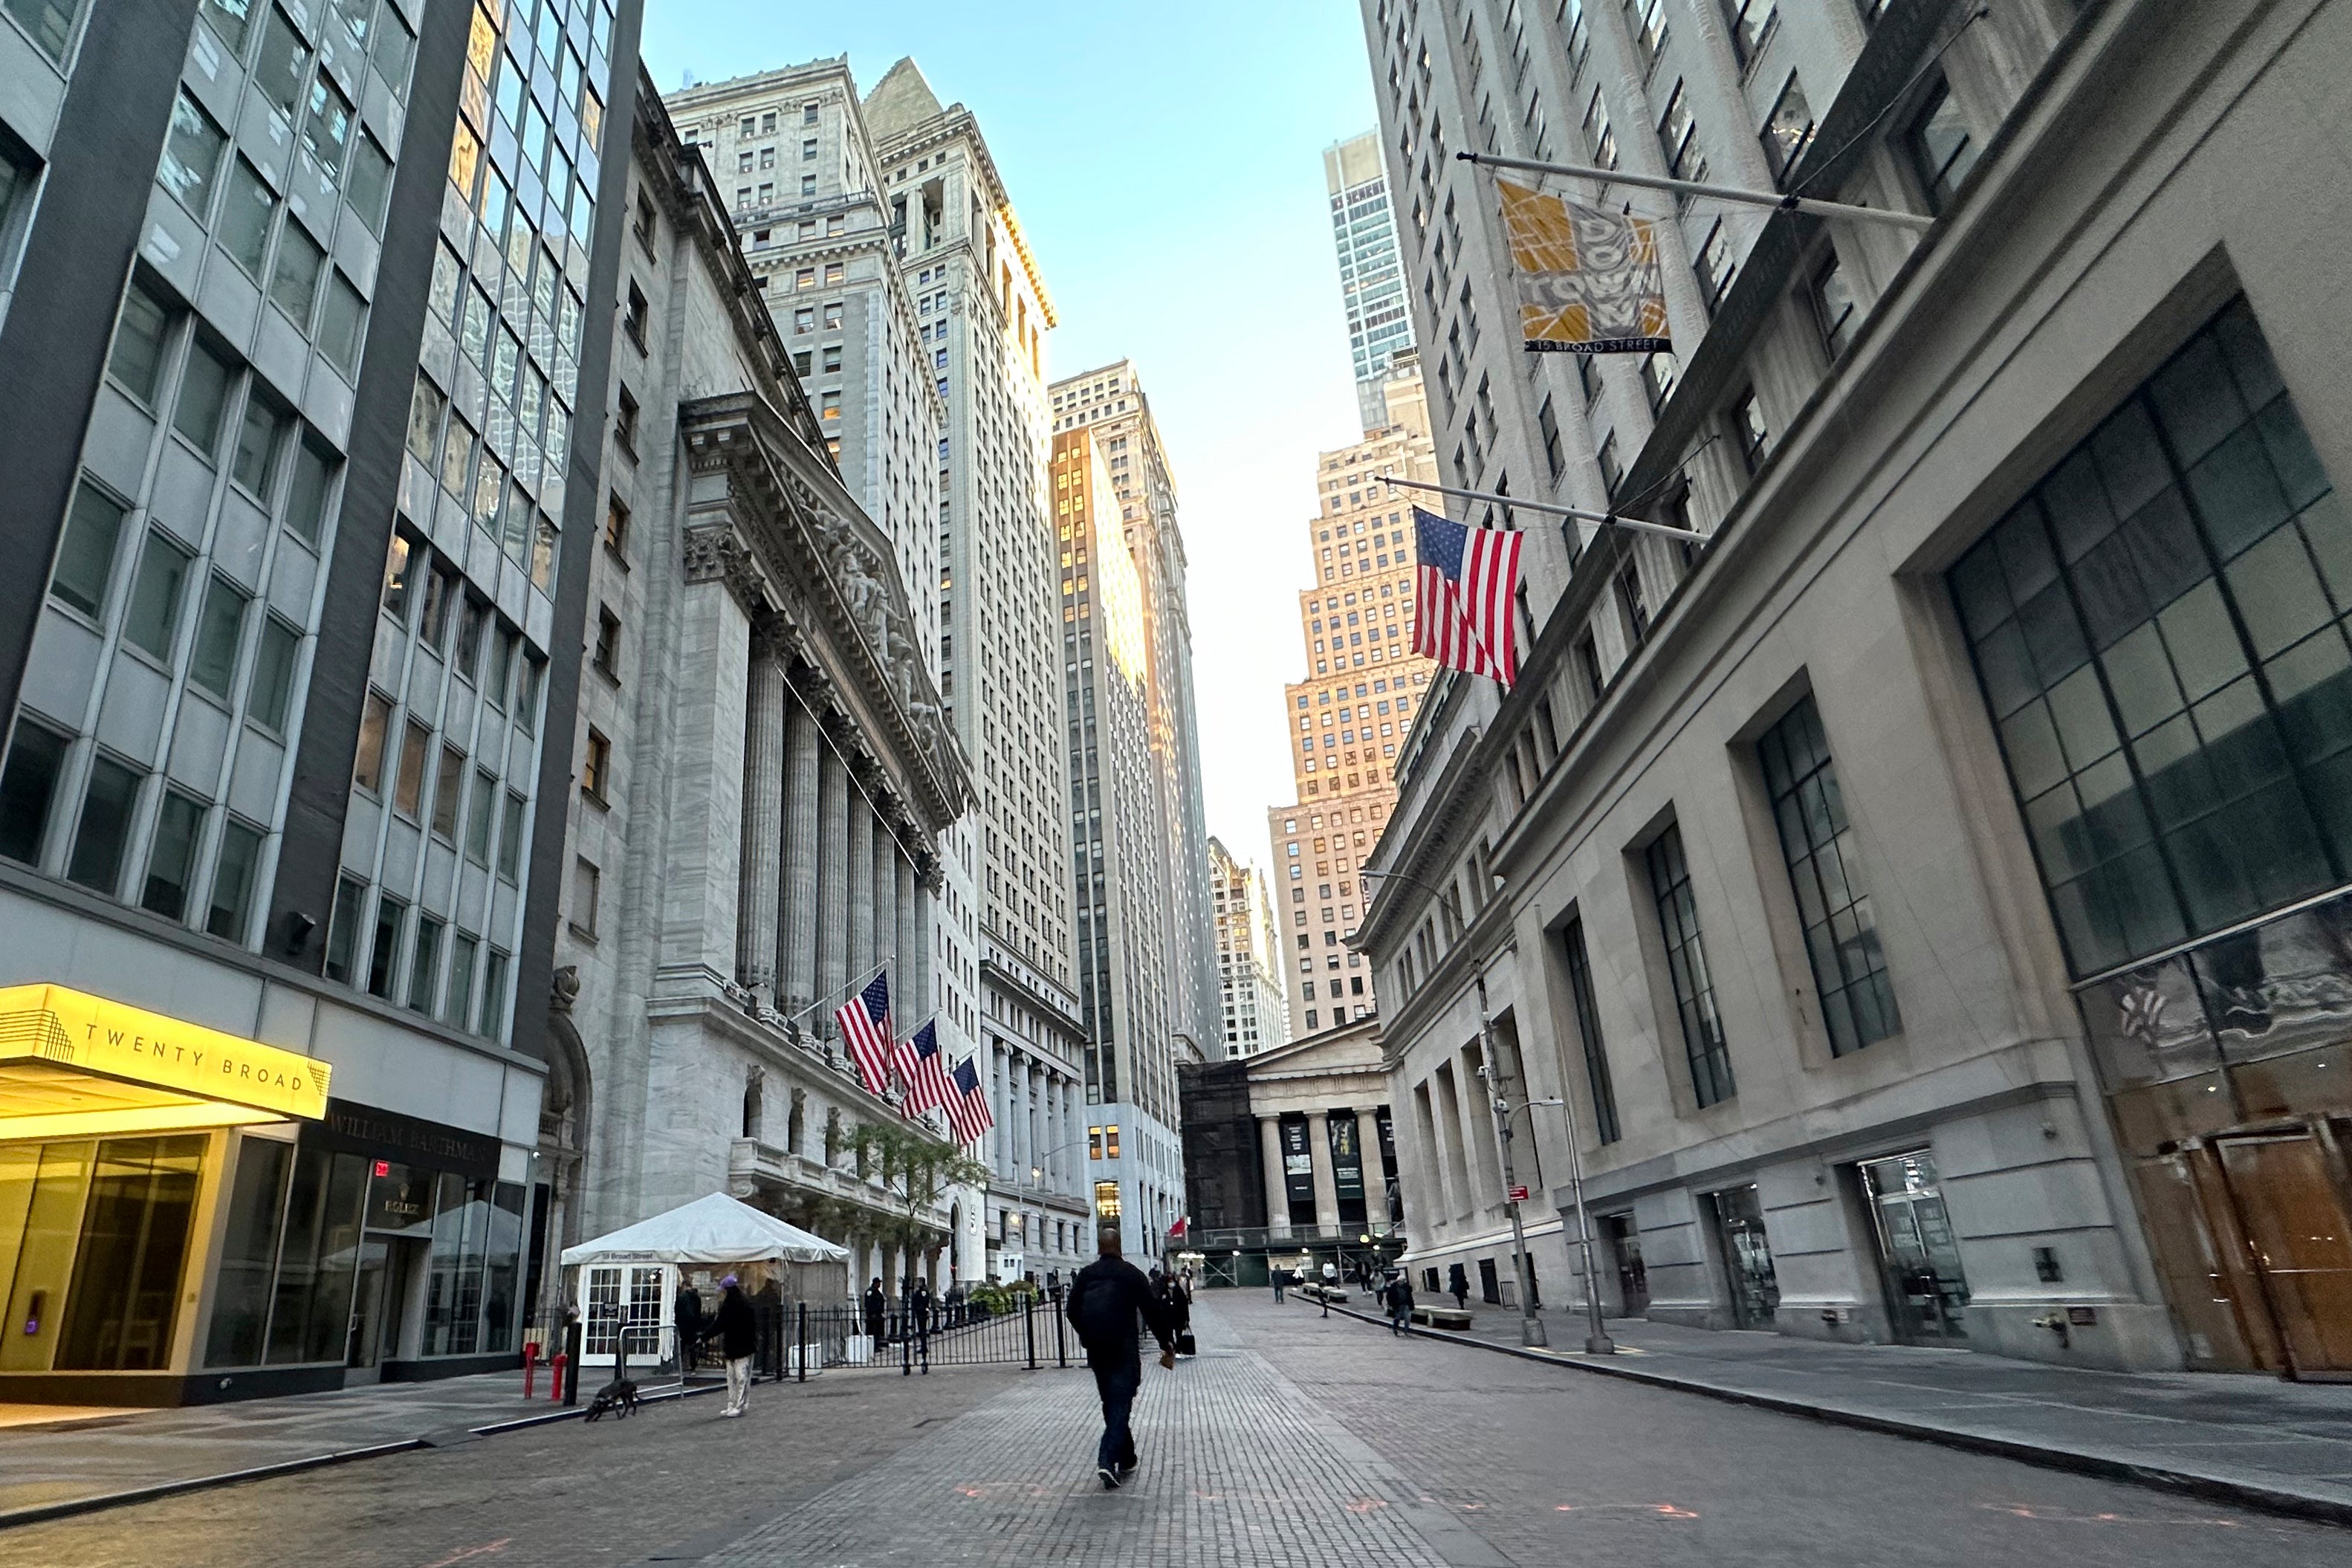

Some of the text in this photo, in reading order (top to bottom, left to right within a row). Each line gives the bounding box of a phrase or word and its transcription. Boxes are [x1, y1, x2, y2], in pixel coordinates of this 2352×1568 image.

[1538, 340, 1659, 352] 15 BROAD STREET
[86, 1023, 302, 1091] TWENTY BROAD
[330, 1113, 404, 1146] WILLIAM
